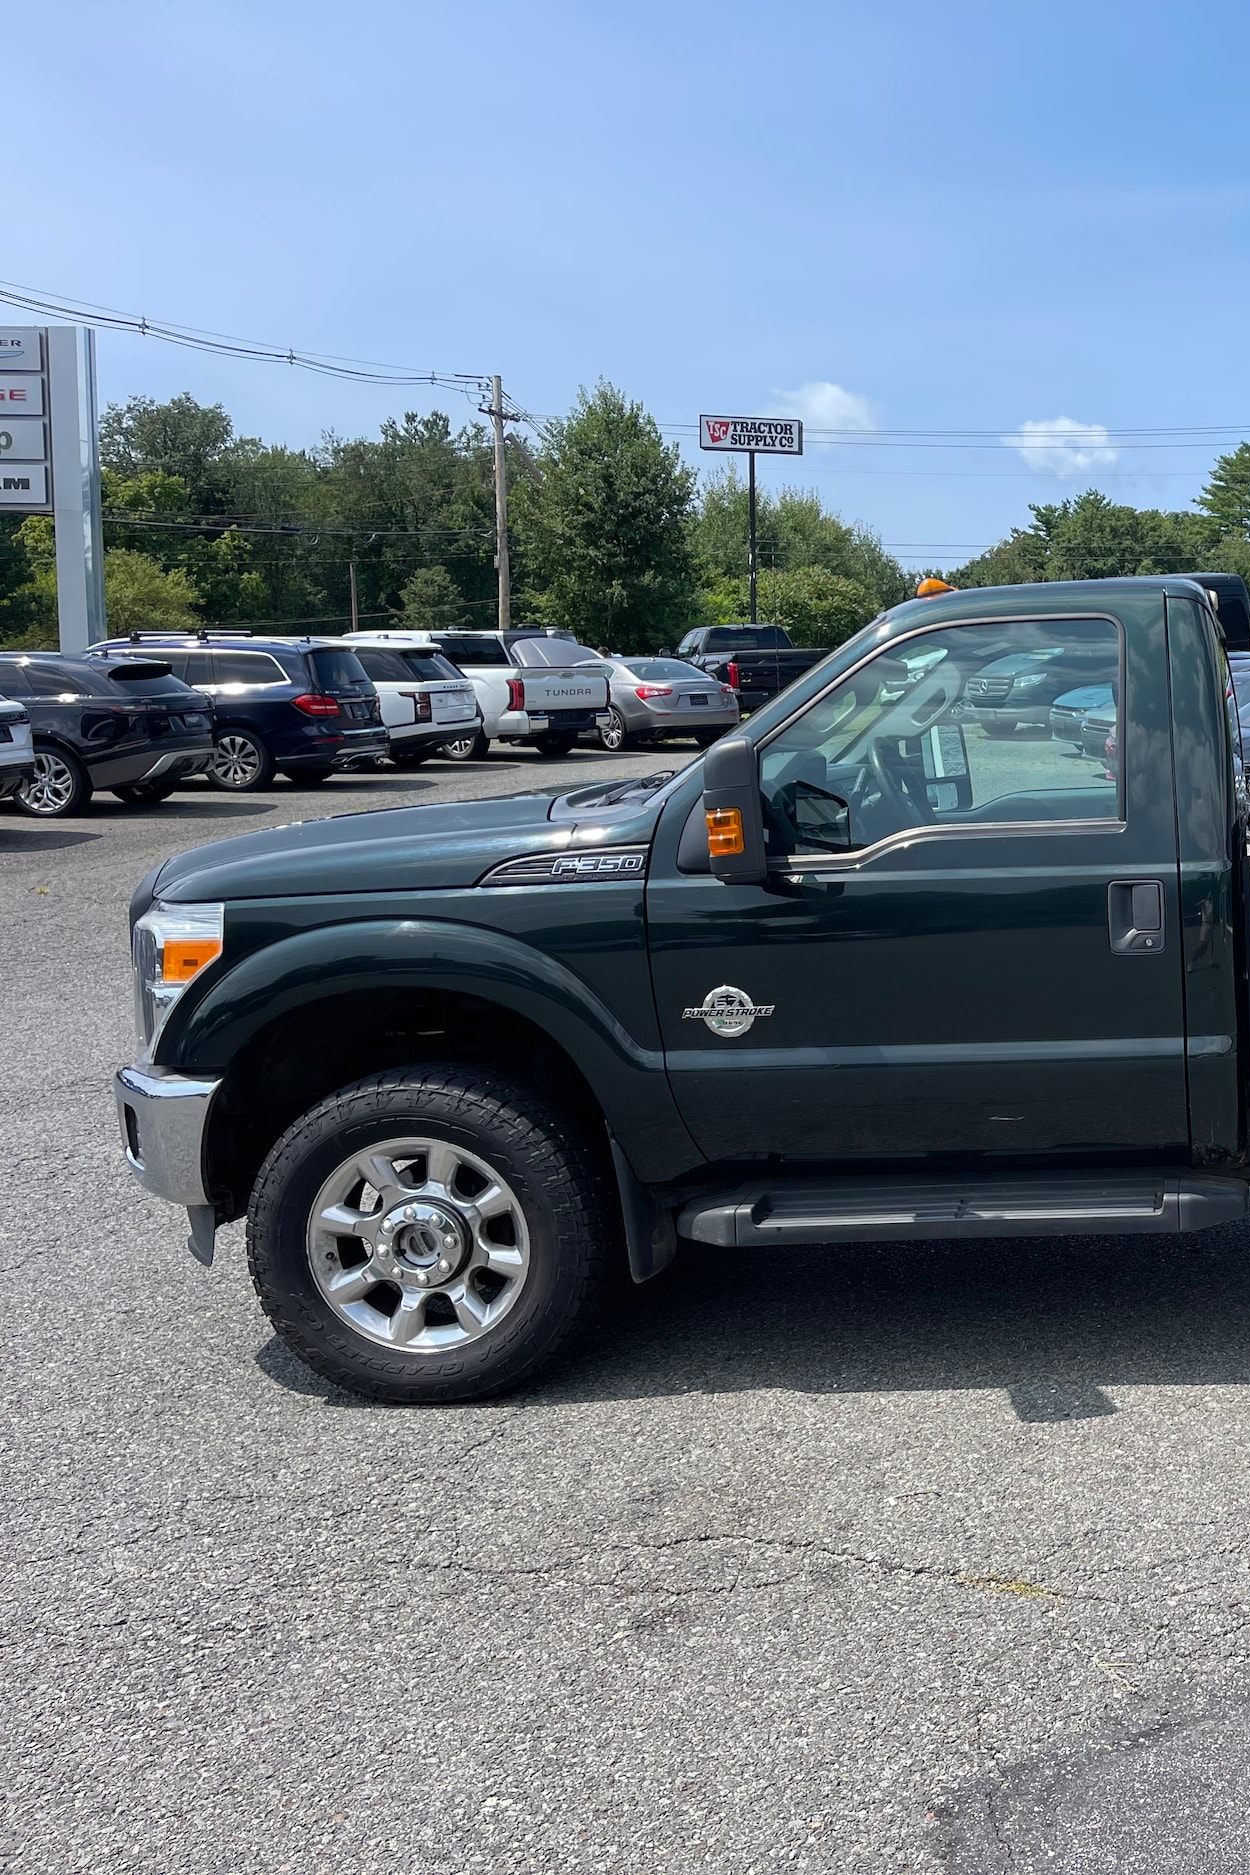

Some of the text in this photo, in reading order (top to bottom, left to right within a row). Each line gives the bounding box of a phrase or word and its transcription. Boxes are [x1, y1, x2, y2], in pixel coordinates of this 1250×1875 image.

[707, 420, 727, 440] TSC
[731, 420, 793, 436] TRACTOR
[730, 433, 778, 447] SUPPLY
[544, 688, 592, 697] TUNDRA
[682, 1005, 775, 1019] POWER STROKE
